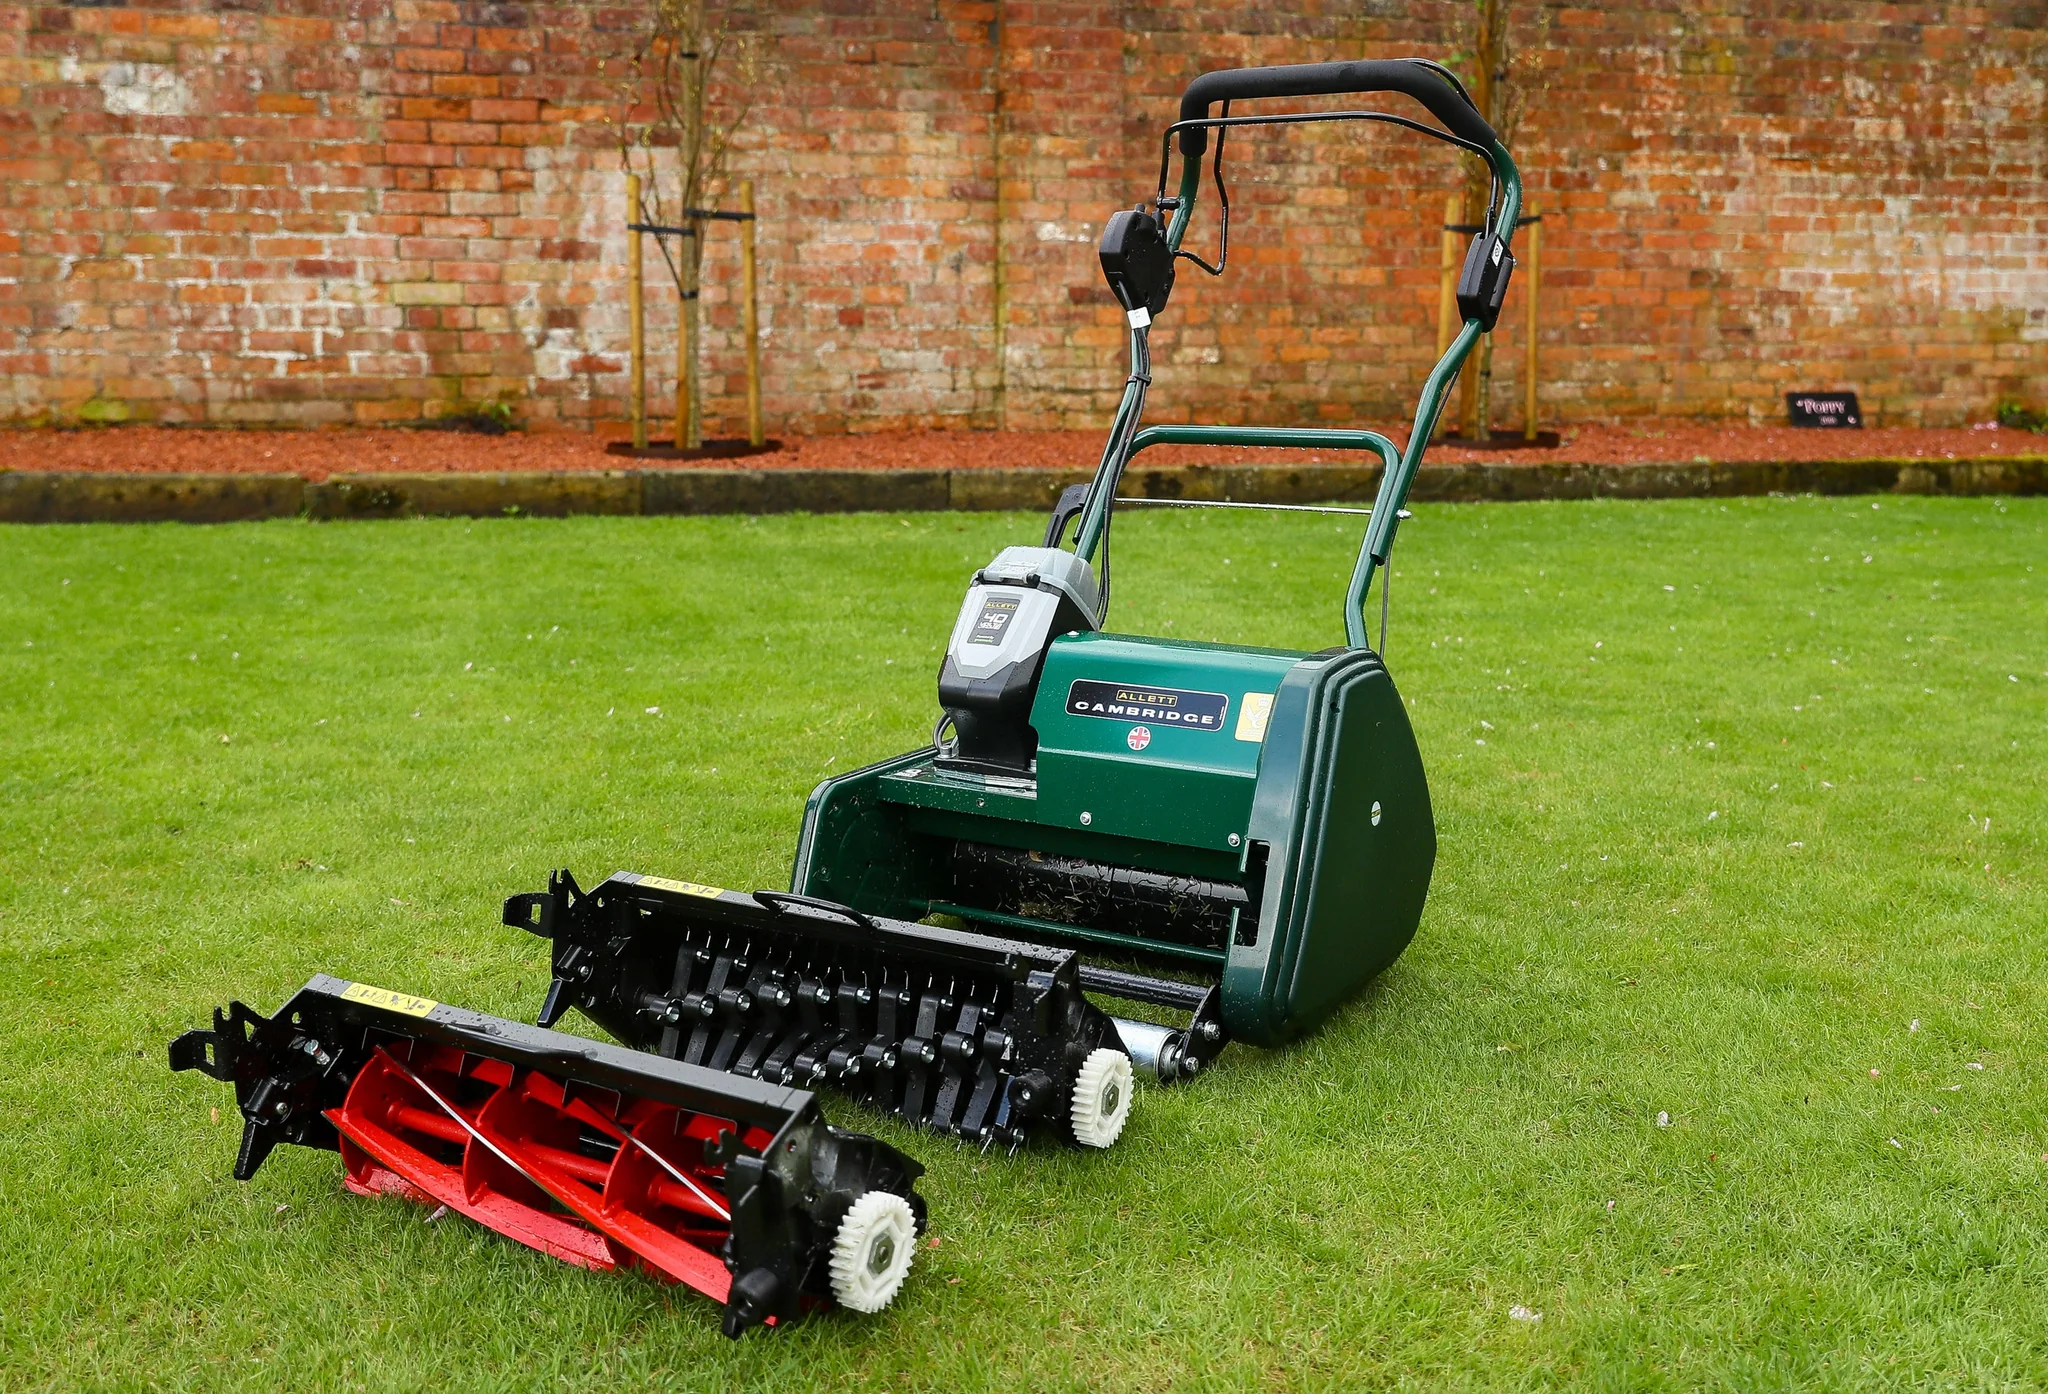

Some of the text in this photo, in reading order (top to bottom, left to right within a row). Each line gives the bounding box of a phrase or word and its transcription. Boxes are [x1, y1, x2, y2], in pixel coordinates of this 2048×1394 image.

[984, 612, 1009, 624] 40
[1118, 692, 1176, 705] ALLETT
[1074, 701, 1215, 725] CAMBRIDGE
